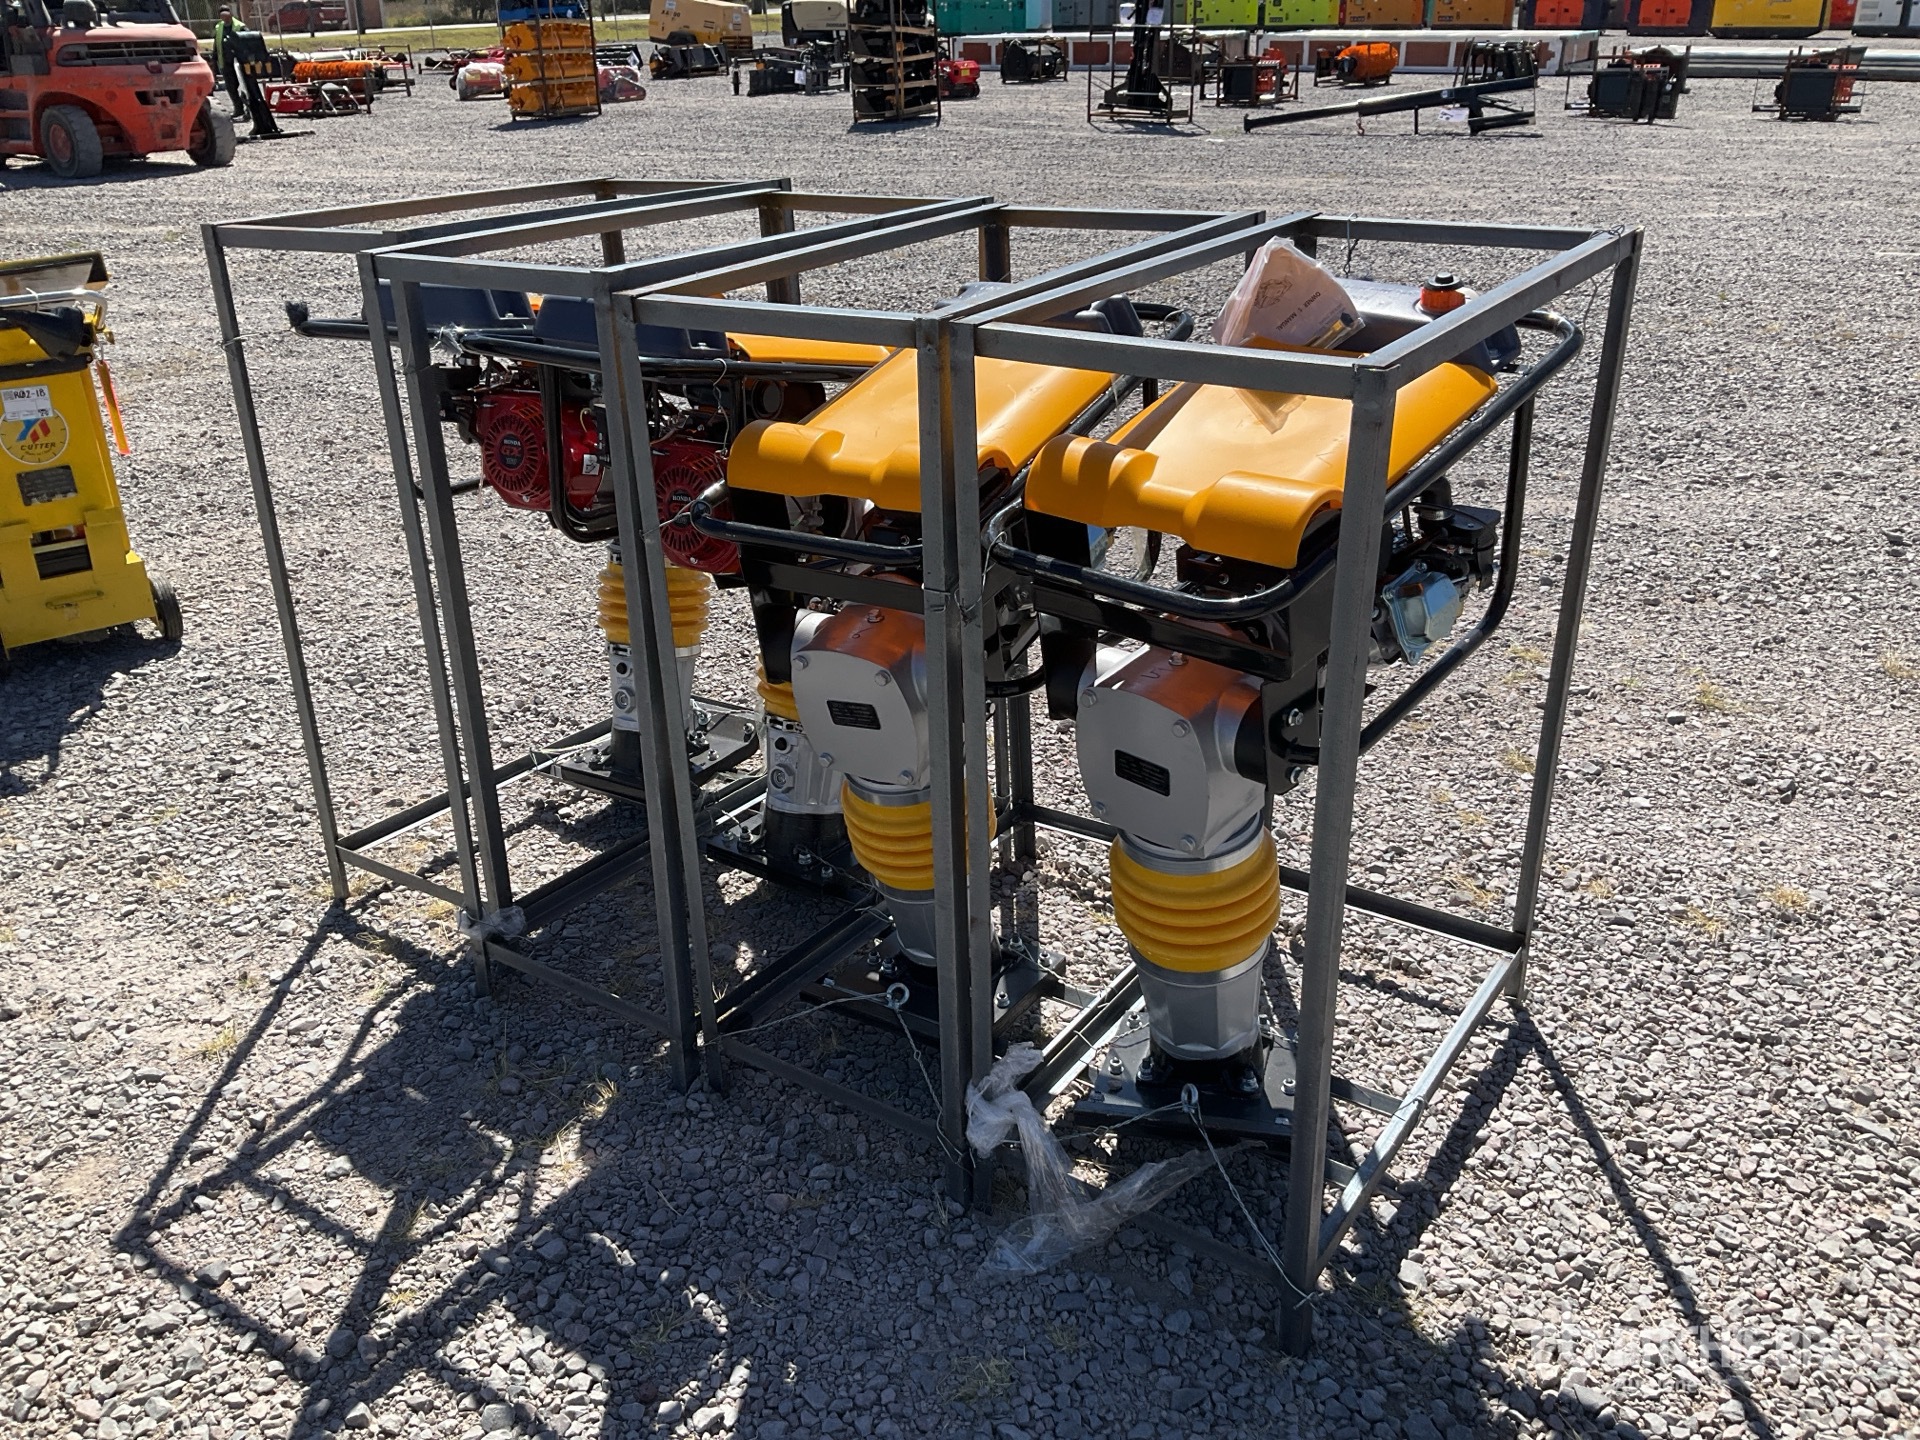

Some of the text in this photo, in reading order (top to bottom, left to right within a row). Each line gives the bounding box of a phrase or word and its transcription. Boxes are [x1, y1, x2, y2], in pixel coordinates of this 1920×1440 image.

[1303, 291, 1321, 308] OWNER
[1275, 312, 1297, 331] MANUAL
[20, 442, 56, 450] CUTTER
